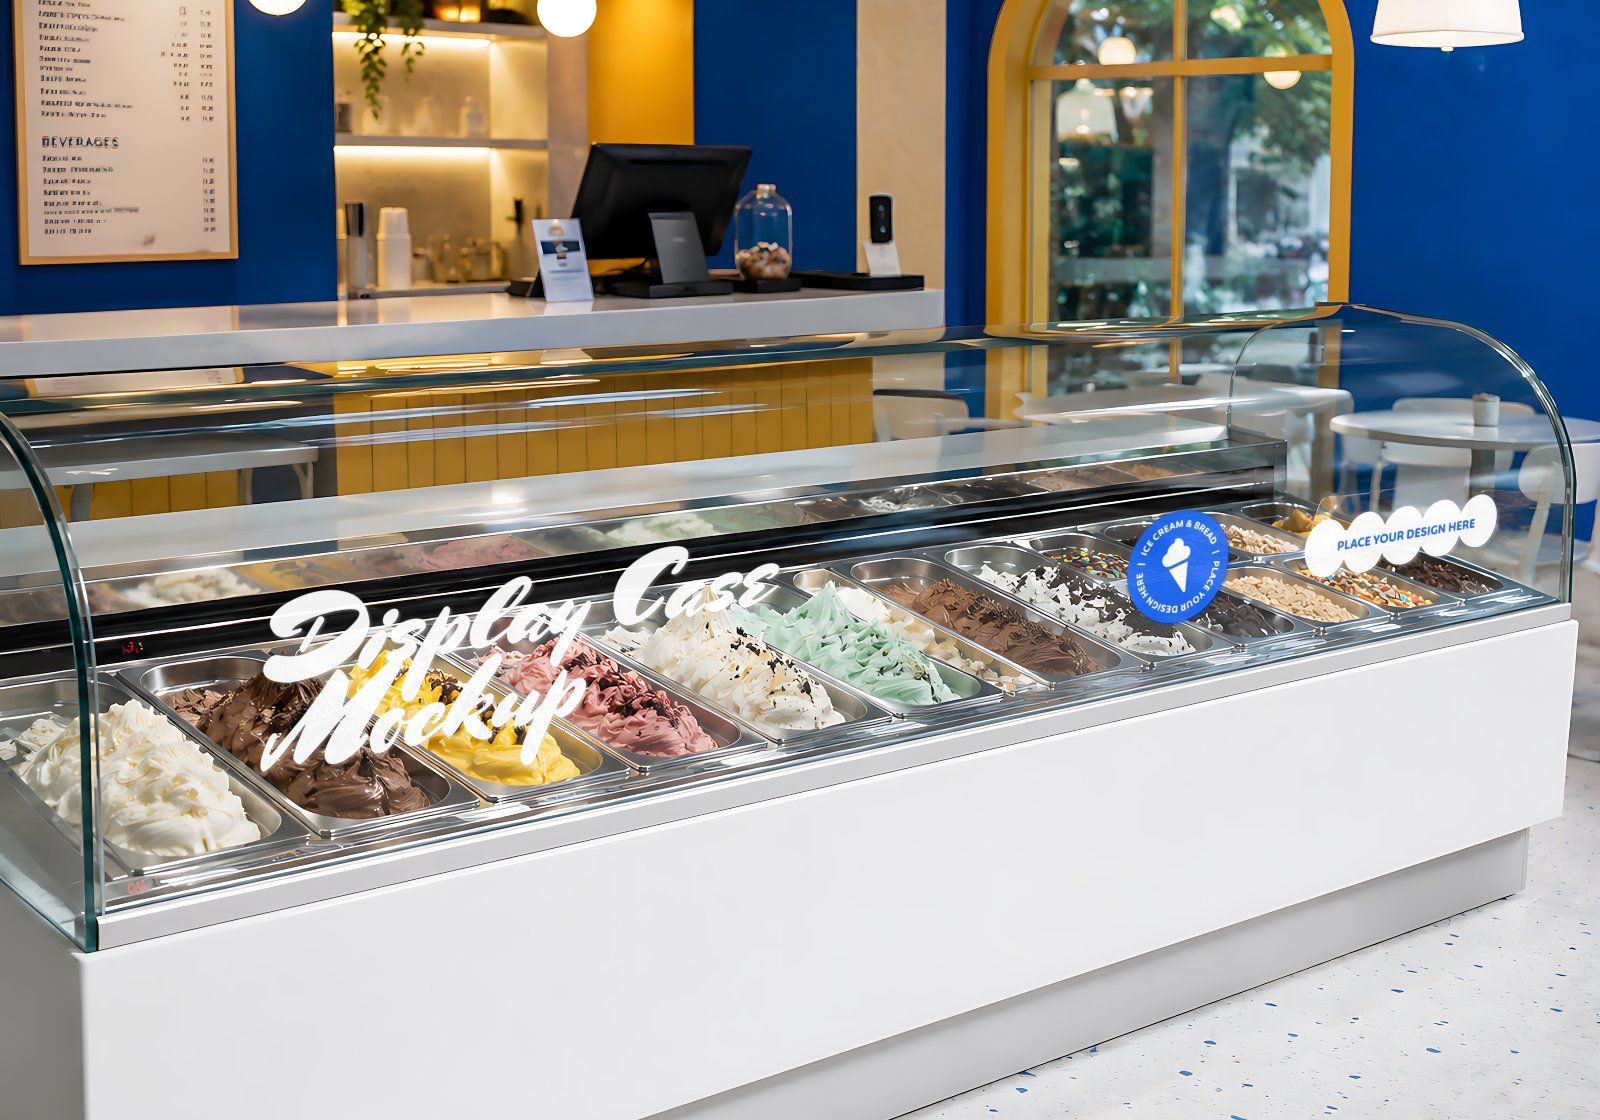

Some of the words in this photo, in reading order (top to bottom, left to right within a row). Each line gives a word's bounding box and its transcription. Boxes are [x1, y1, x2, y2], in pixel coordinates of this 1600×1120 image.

[1140, 540, 1154, 557] ICE
[1152, 519, 1184, 541] CREAM
[1185, 519, 1193, 528] &
[1193, 521, 1218, 545] BREAD
[1337, 535, 1371, 551] PLACE
[1373, 530, 1404, 545] YOUR
[1406, 523, 1446, 540] DESIGN
[1448, 518, 1476, 533] HERE
[1135, 572, 1149, 599] HERE
[1202, 560, 1221, 592] PLACE
[1145, 596, 1178, 614] DESIGN
[1180, 591, 1206, 612] YOUR
[263, 575, 592, 701] Display
[613, 545, 781, 626] Case
[259, 653, 586, 773] Mockup
